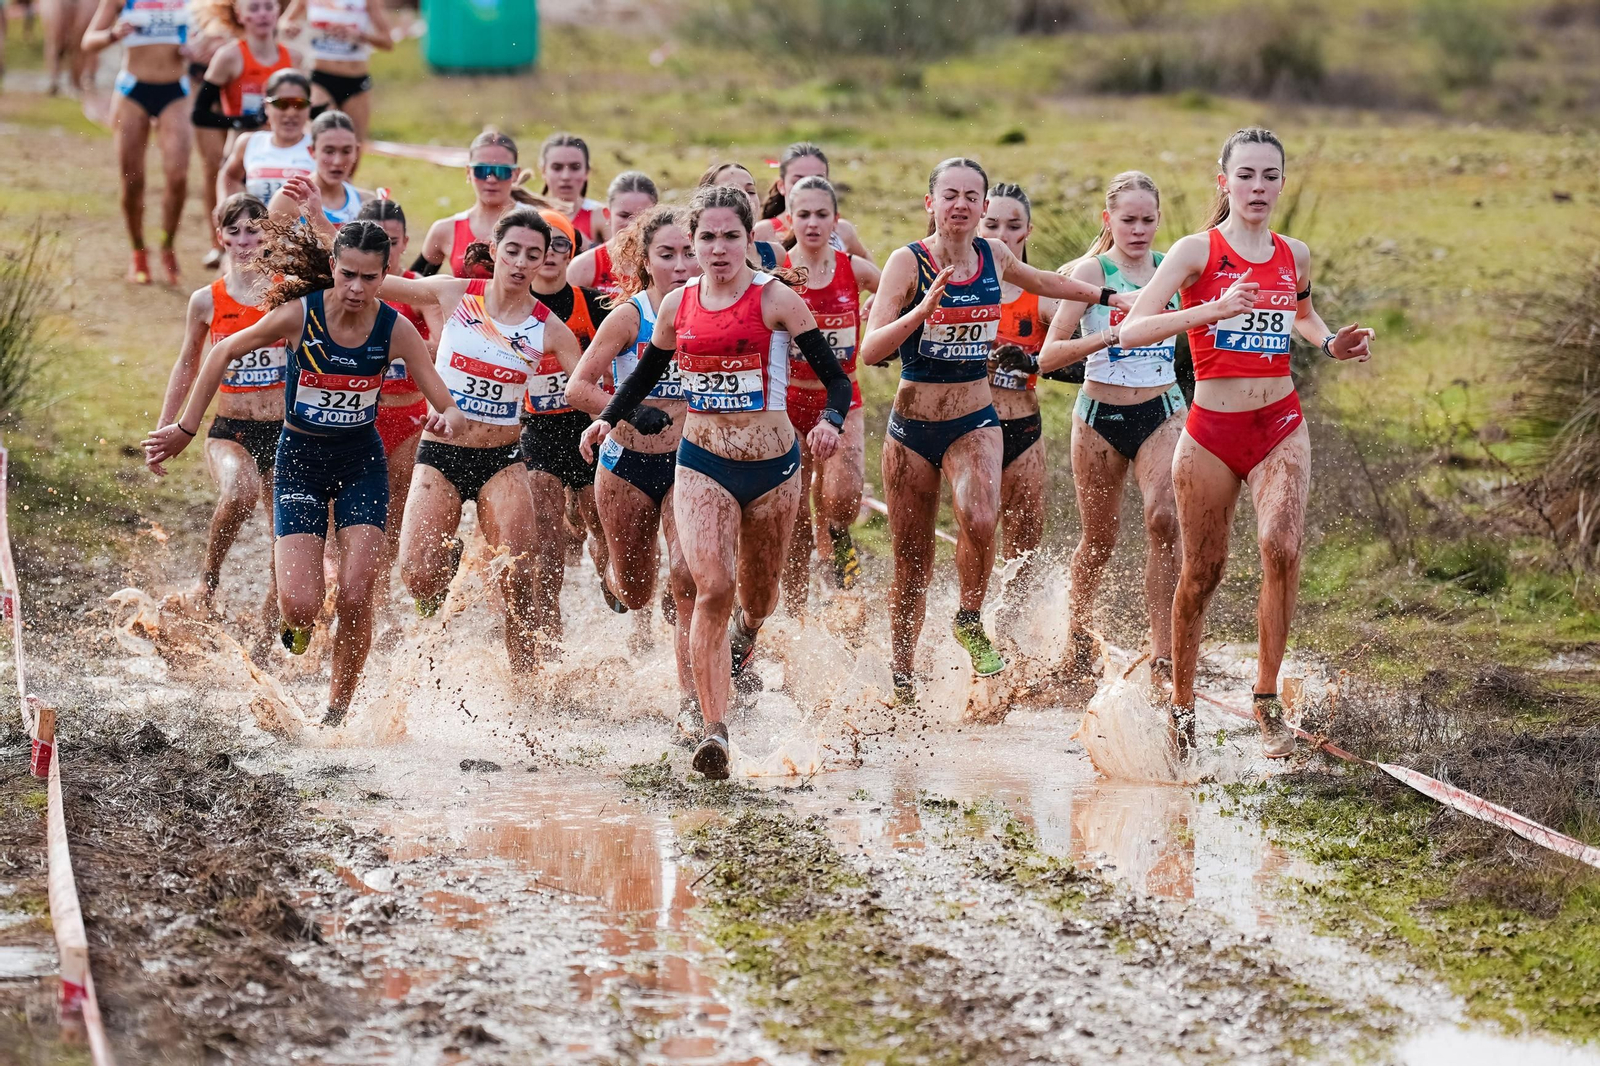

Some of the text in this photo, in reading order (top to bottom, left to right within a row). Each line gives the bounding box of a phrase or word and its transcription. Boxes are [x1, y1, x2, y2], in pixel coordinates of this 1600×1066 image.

[951, 294, 980, 303] FCA
[1241, 311, 1284, 333] 358
[943, 324, 982, 343] 320
[1241, 334, 1287, 349] Joma
[330, 354, 358, 366] FCA
[462, 376, 503, 401] 339
[547, 373, 568, 394] 33
[697, 373, 739, 393] 329
[318, 390, 361, 410] 324
[460, 397, 508, 415] Joma
[318, 410, 367, 423] Joma
